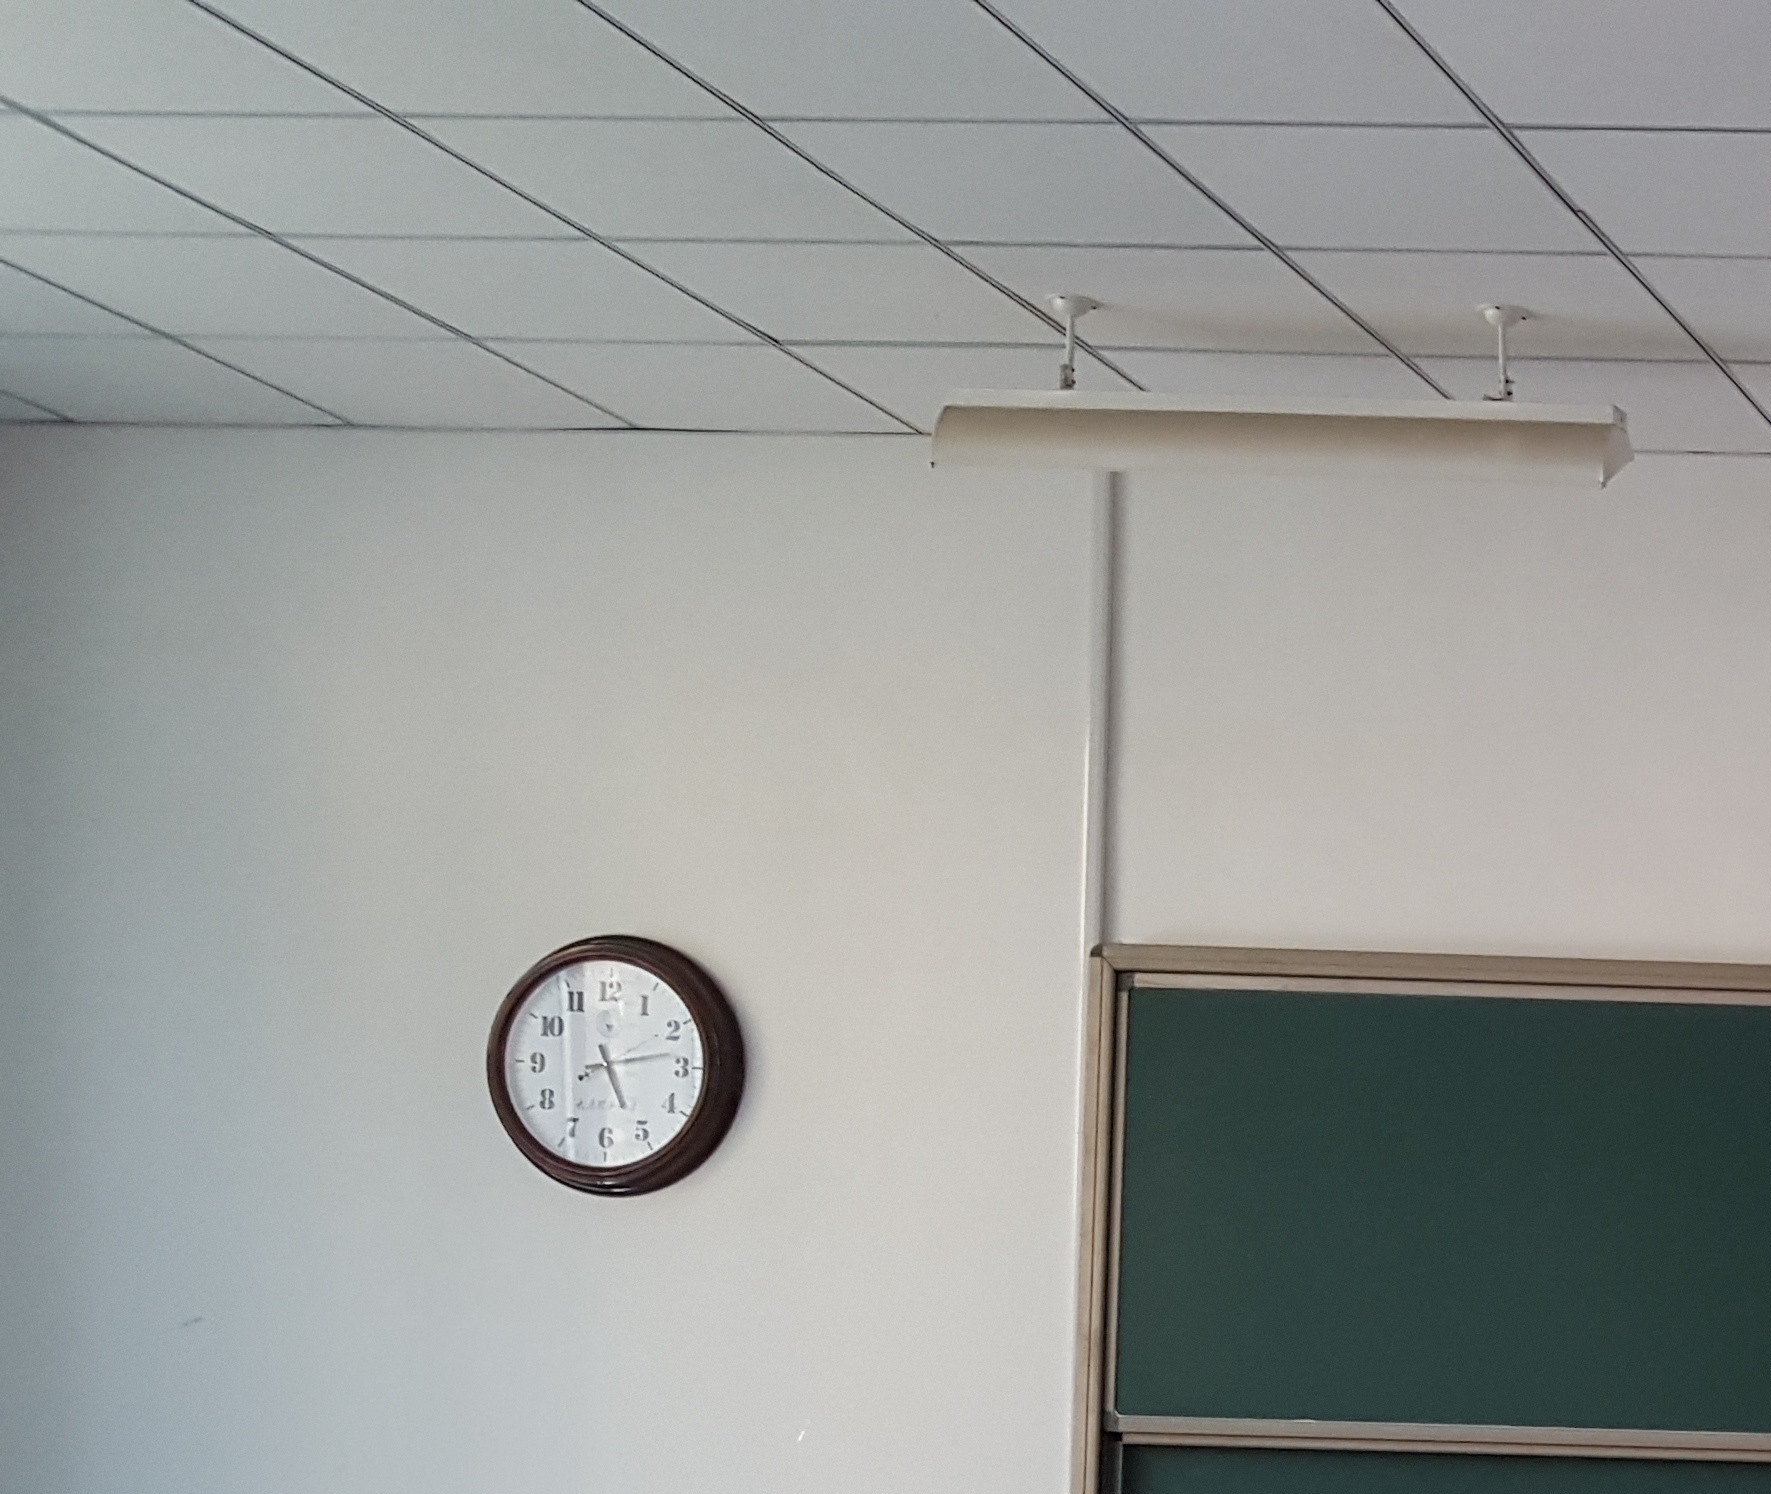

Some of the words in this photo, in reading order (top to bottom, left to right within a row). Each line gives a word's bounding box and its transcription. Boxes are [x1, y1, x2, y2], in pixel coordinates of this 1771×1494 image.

[566, 990, 585, 1012] 11
[599, 980, 623, 1002] 12
[640, 994, 649, 1016] 1
[540, 1015, 564, 1037] 10
[665, 1020, 681, 1041] 2
[530, 1052, 546, 1073] 9
[674, 1057, 689, 1078] 3
[539, 1088, 555, 1110] 8
[661, 1092, 676, 1114] 4
[566, 1116, 580, 1138] 7
[598, 1127, 614, 1148] 6
[634, 1120, 650, 1141] 5
